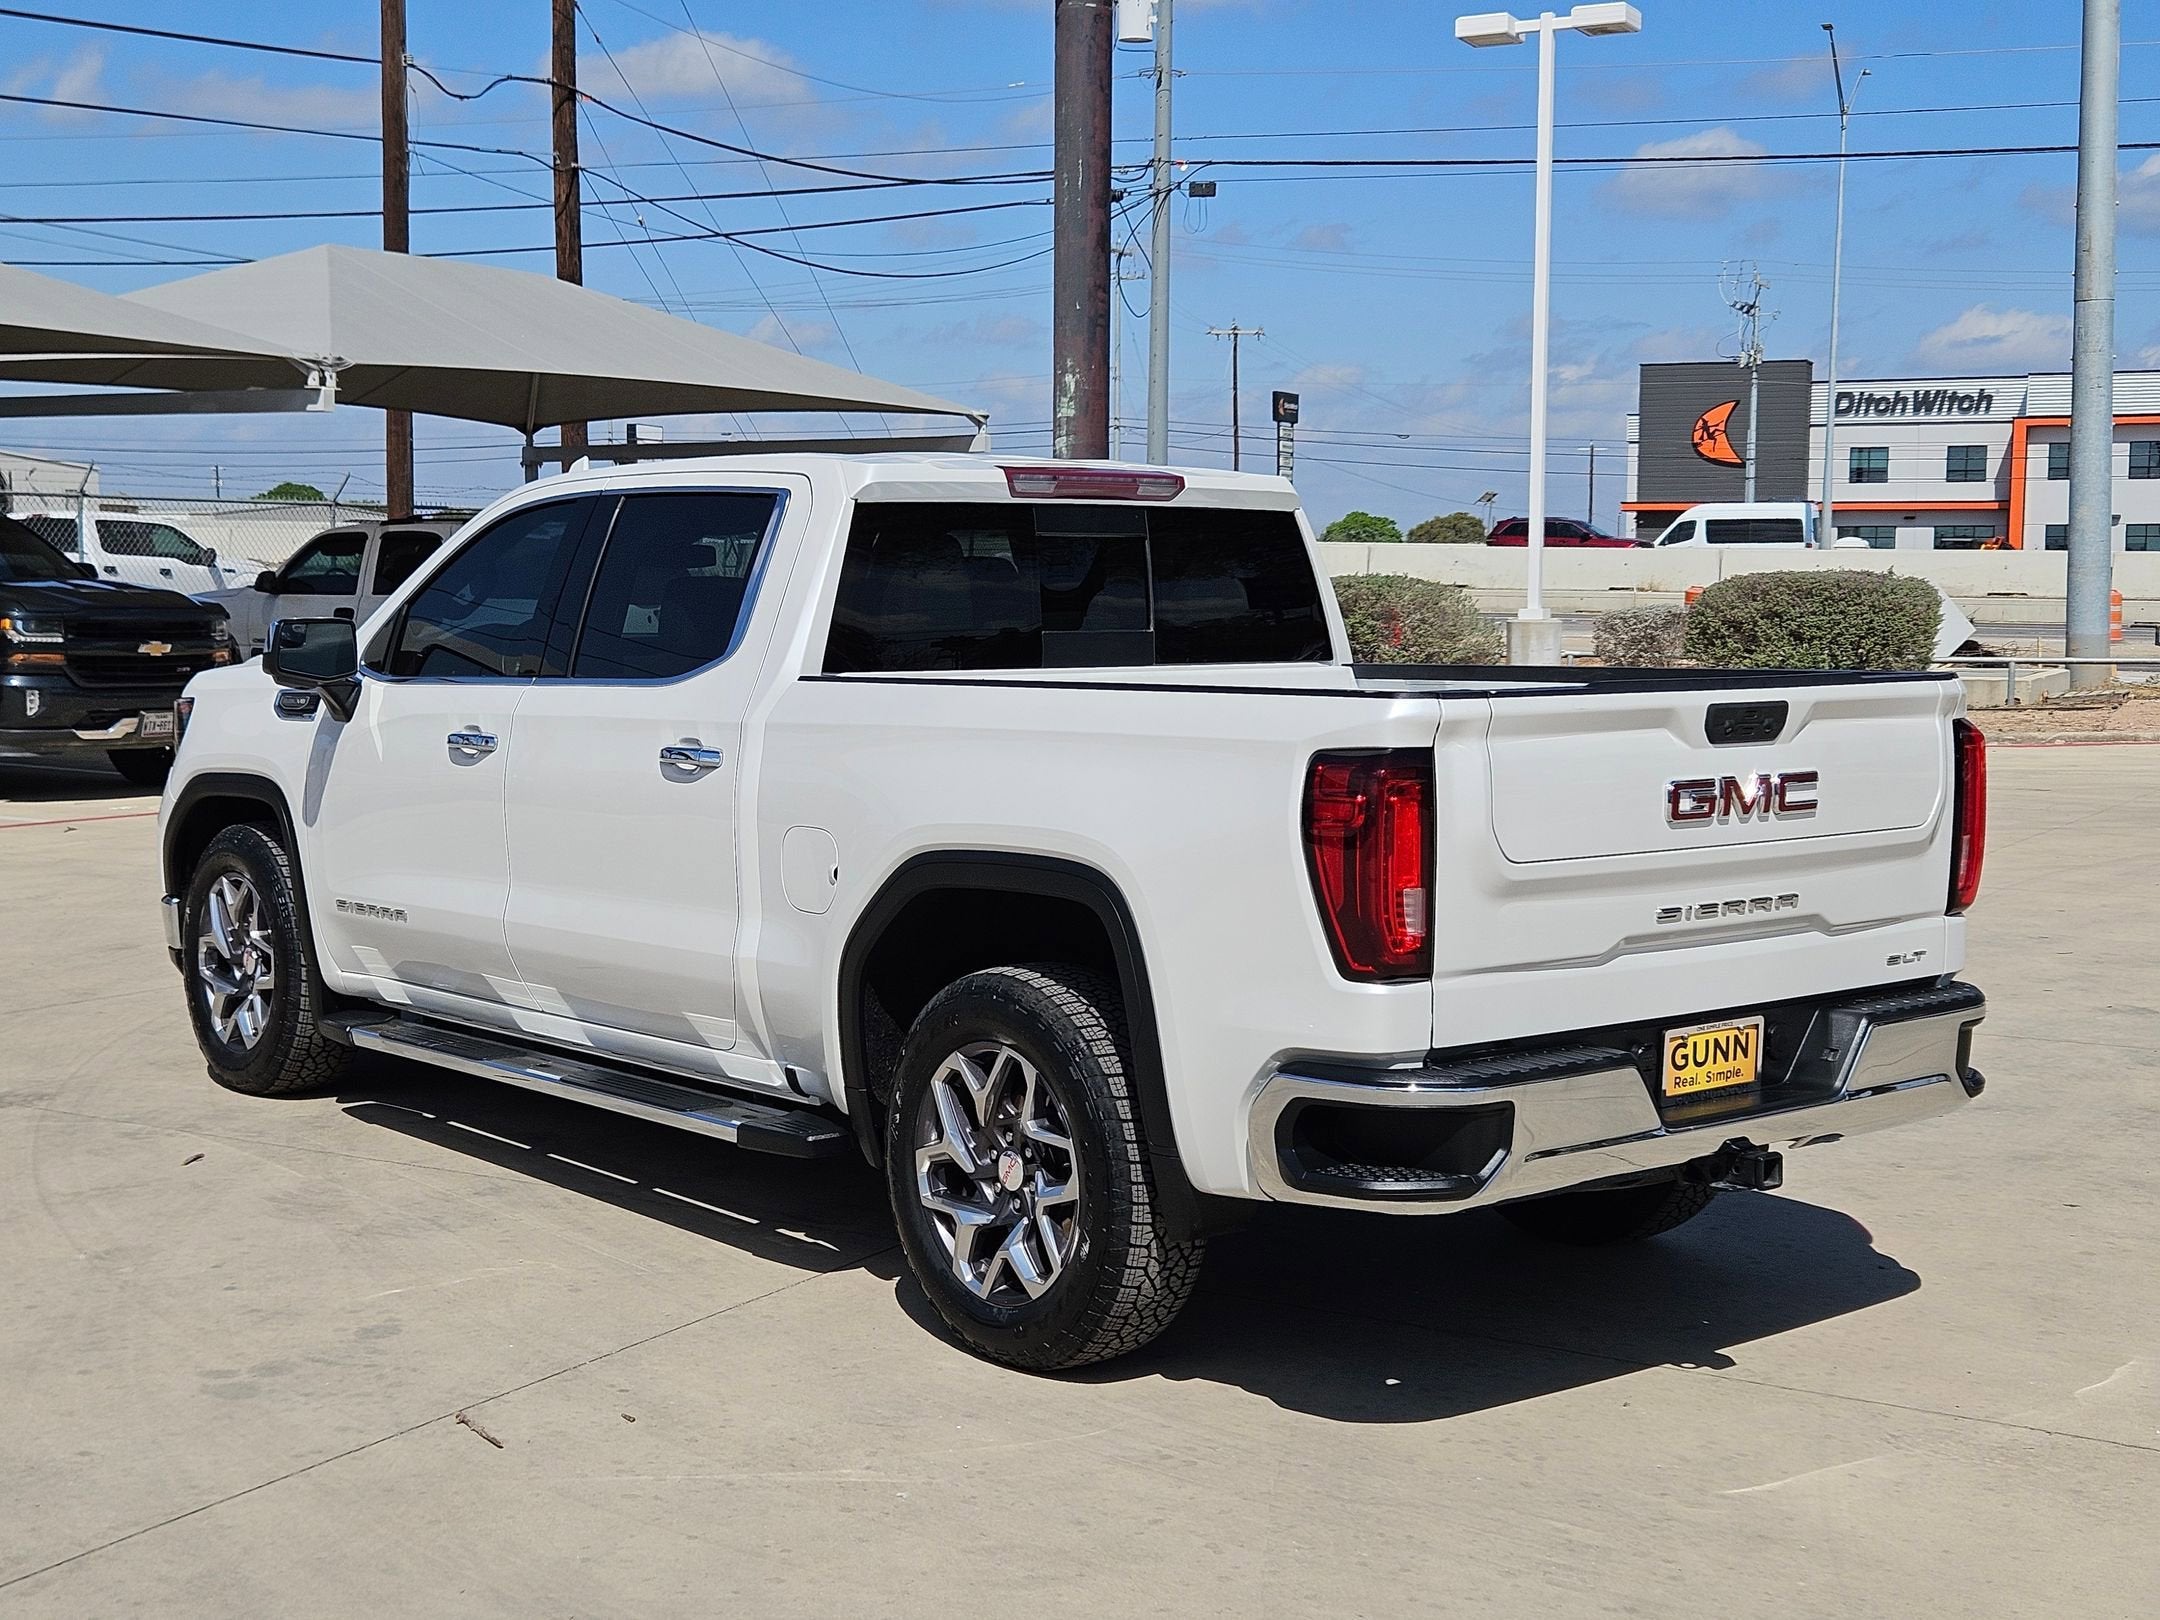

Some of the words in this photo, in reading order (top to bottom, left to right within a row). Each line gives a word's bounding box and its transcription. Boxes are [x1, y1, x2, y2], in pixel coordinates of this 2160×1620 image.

[1835, 390, 1909, 416] Ditch
[1912, 388, 1994, 415] Witch
[1666, 770, 1819, 829] GMC
[335, 898, 408, 923] SIERRA
[1656, 893, 1799, 924] SIERRA
[1886, 950, 1927, 966] SLT
[1670, 1032, 1750, 1072] GUNN
[1673, 1073, 1701, 1089] Real.
